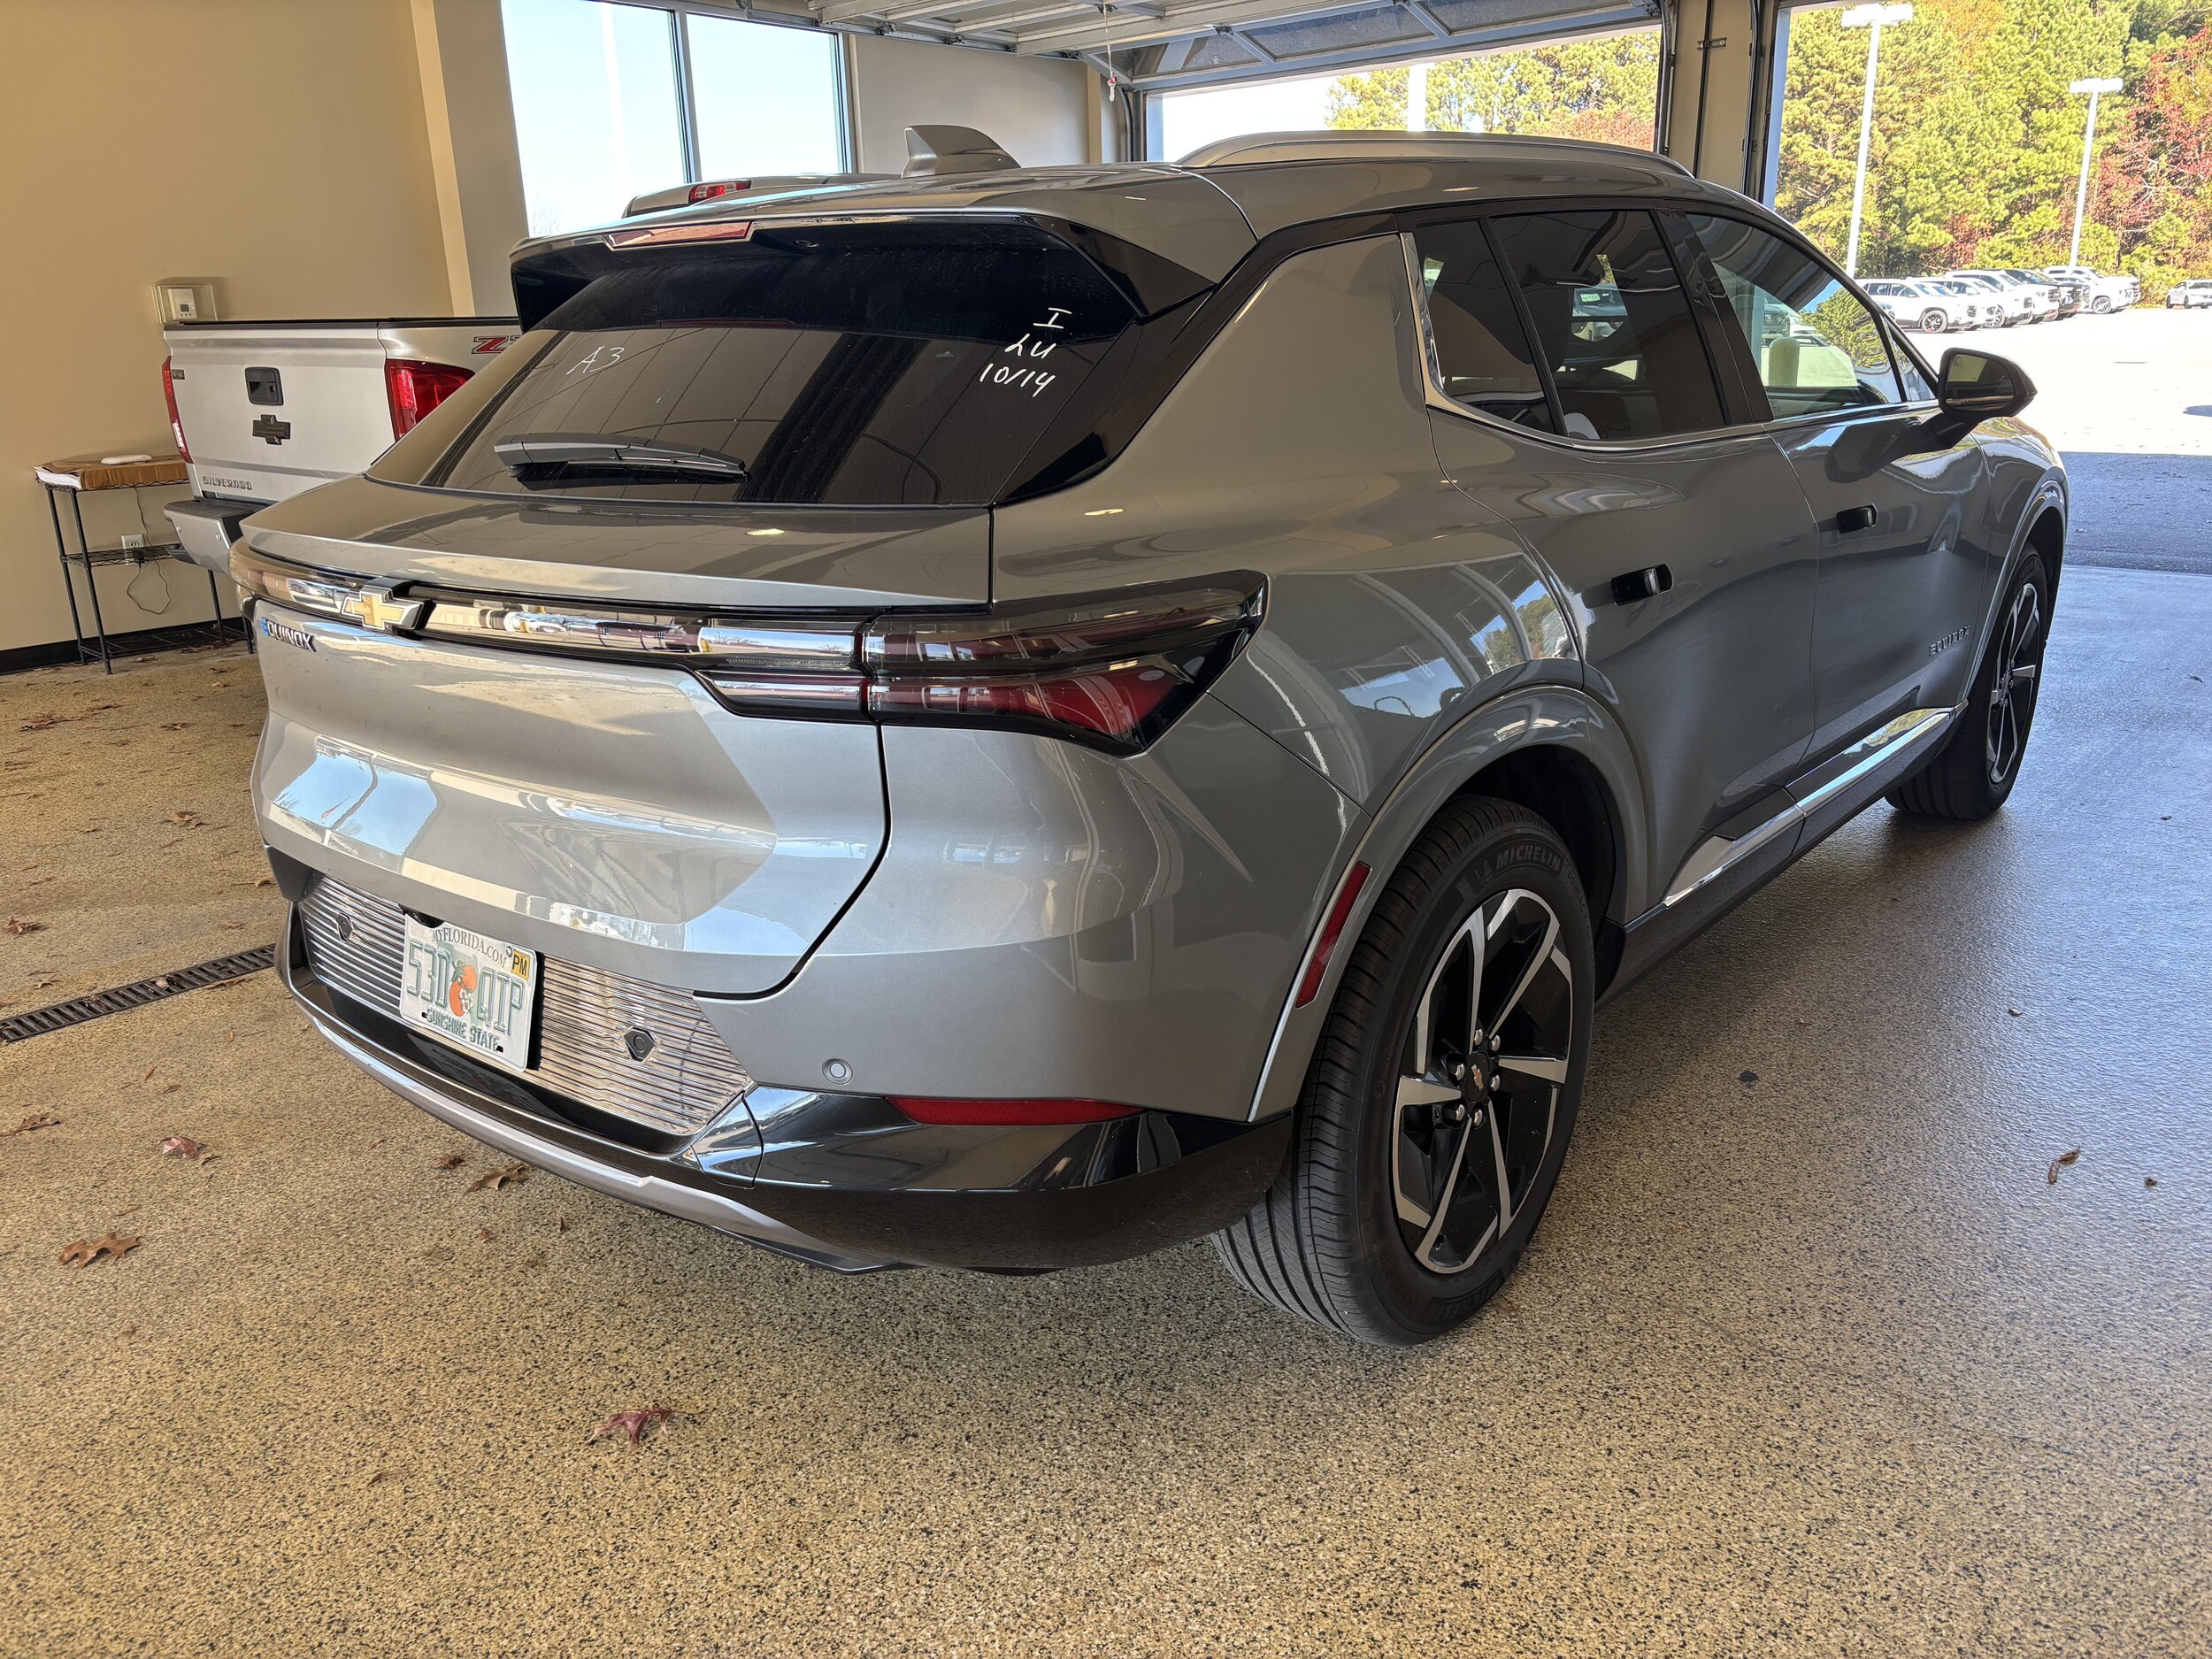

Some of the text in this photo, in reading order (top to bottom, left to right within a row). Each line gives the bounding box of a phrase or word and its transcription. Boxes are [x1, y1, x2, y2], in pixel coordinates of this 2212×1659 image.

[979, 363, 1056, 397] 10/14
[202, 476, 252, 491] SILVERADO
[1929, 625, 1970, 657] EQUINOX
[1495, 844, 1562, 872] MICHELIN
[432, 927, 508, 970] MYFLORIDA.COM
[407, 939, 452, 1009] 53D
[512, 954, 527, 977] PM
[426, 1006, 501, 1052] SUNSHINE STATE
